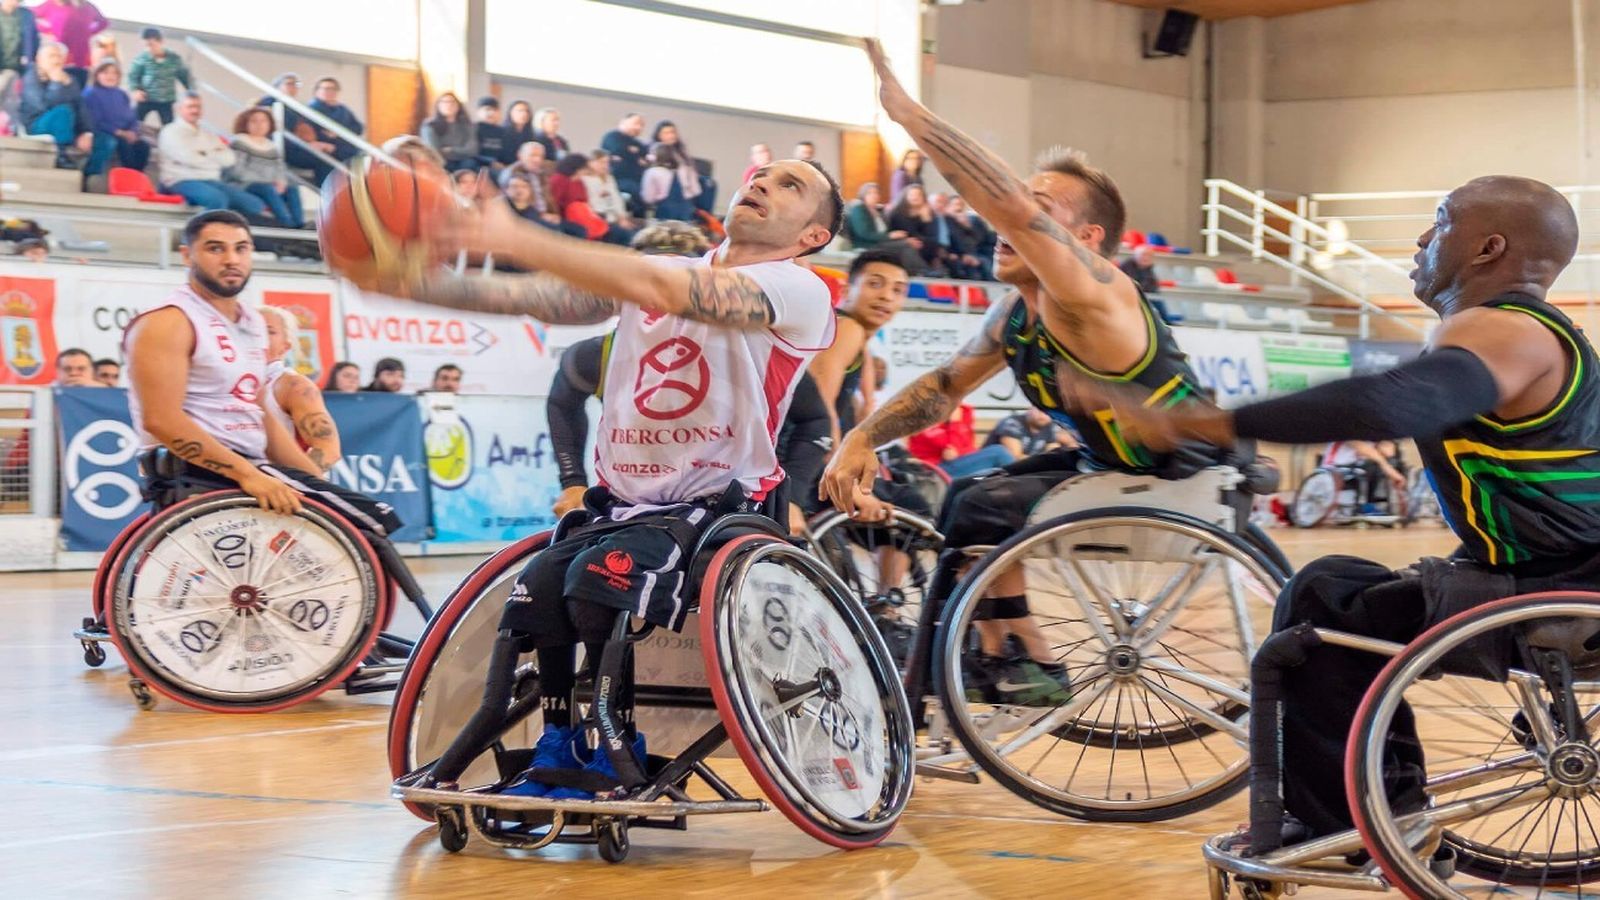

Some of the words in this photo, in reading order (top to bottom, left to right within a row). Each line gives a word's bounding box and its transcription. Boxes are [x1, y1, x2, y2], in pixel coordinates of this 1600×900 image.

[93, 306, 139, 332] CO
[343, 314, 467, 345] avanza
[216, 335, 236, 363] 5
[891, 327, 959, 346] DEPORTE
[610, 424, 735, 445] IBERCONSA
[322, 453, 419, 494] NSA
